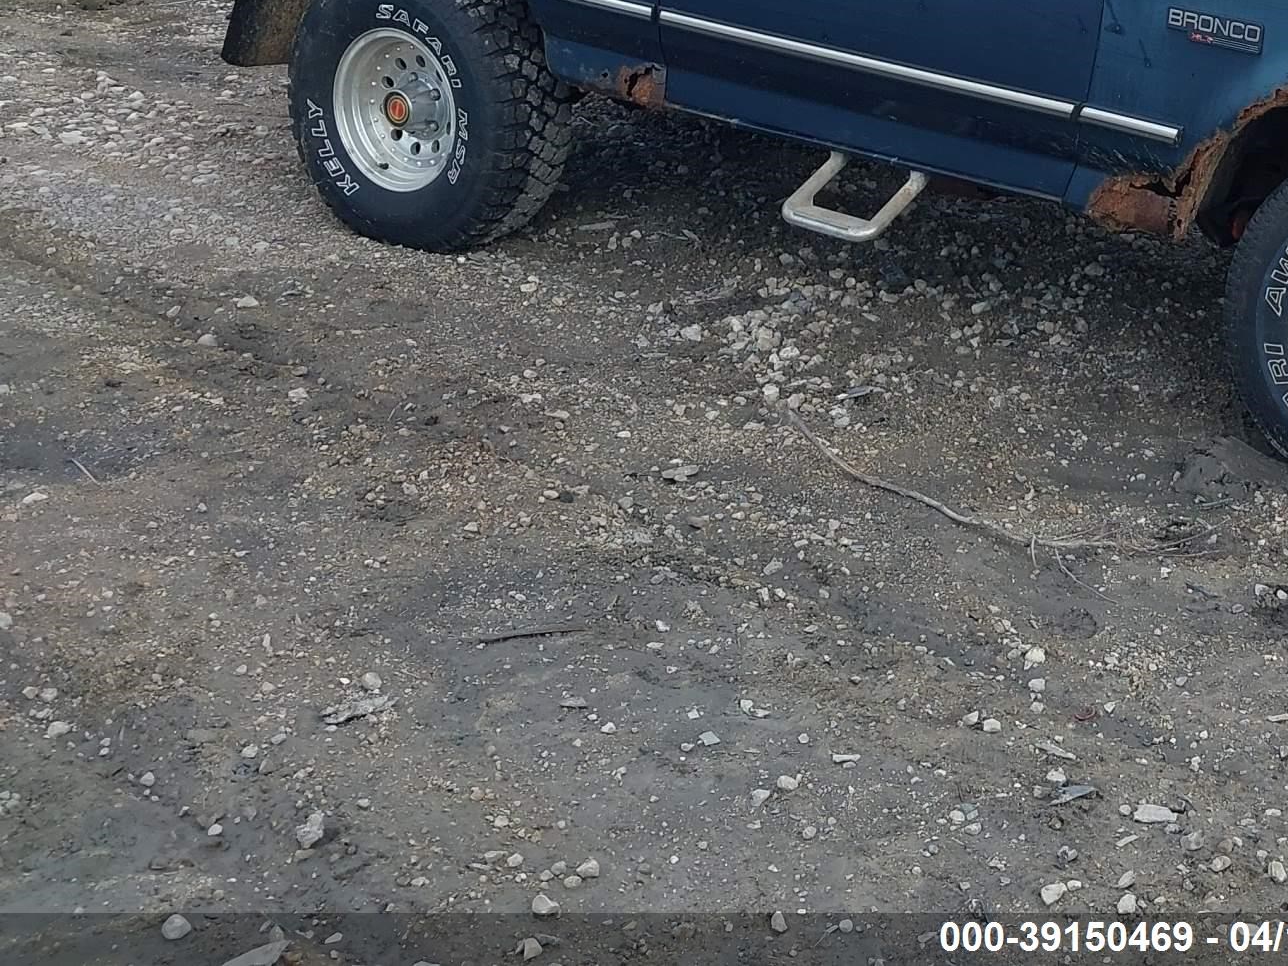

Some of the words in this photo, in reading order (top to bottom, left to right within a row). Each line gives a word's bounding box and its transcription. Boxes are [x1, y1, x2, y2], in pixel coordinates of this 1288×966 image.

[375, 4, 463, 89] SAFARI
[1168, 8, 1261, 43] BRONCO
[305, 98, 360, 196] KELLY
